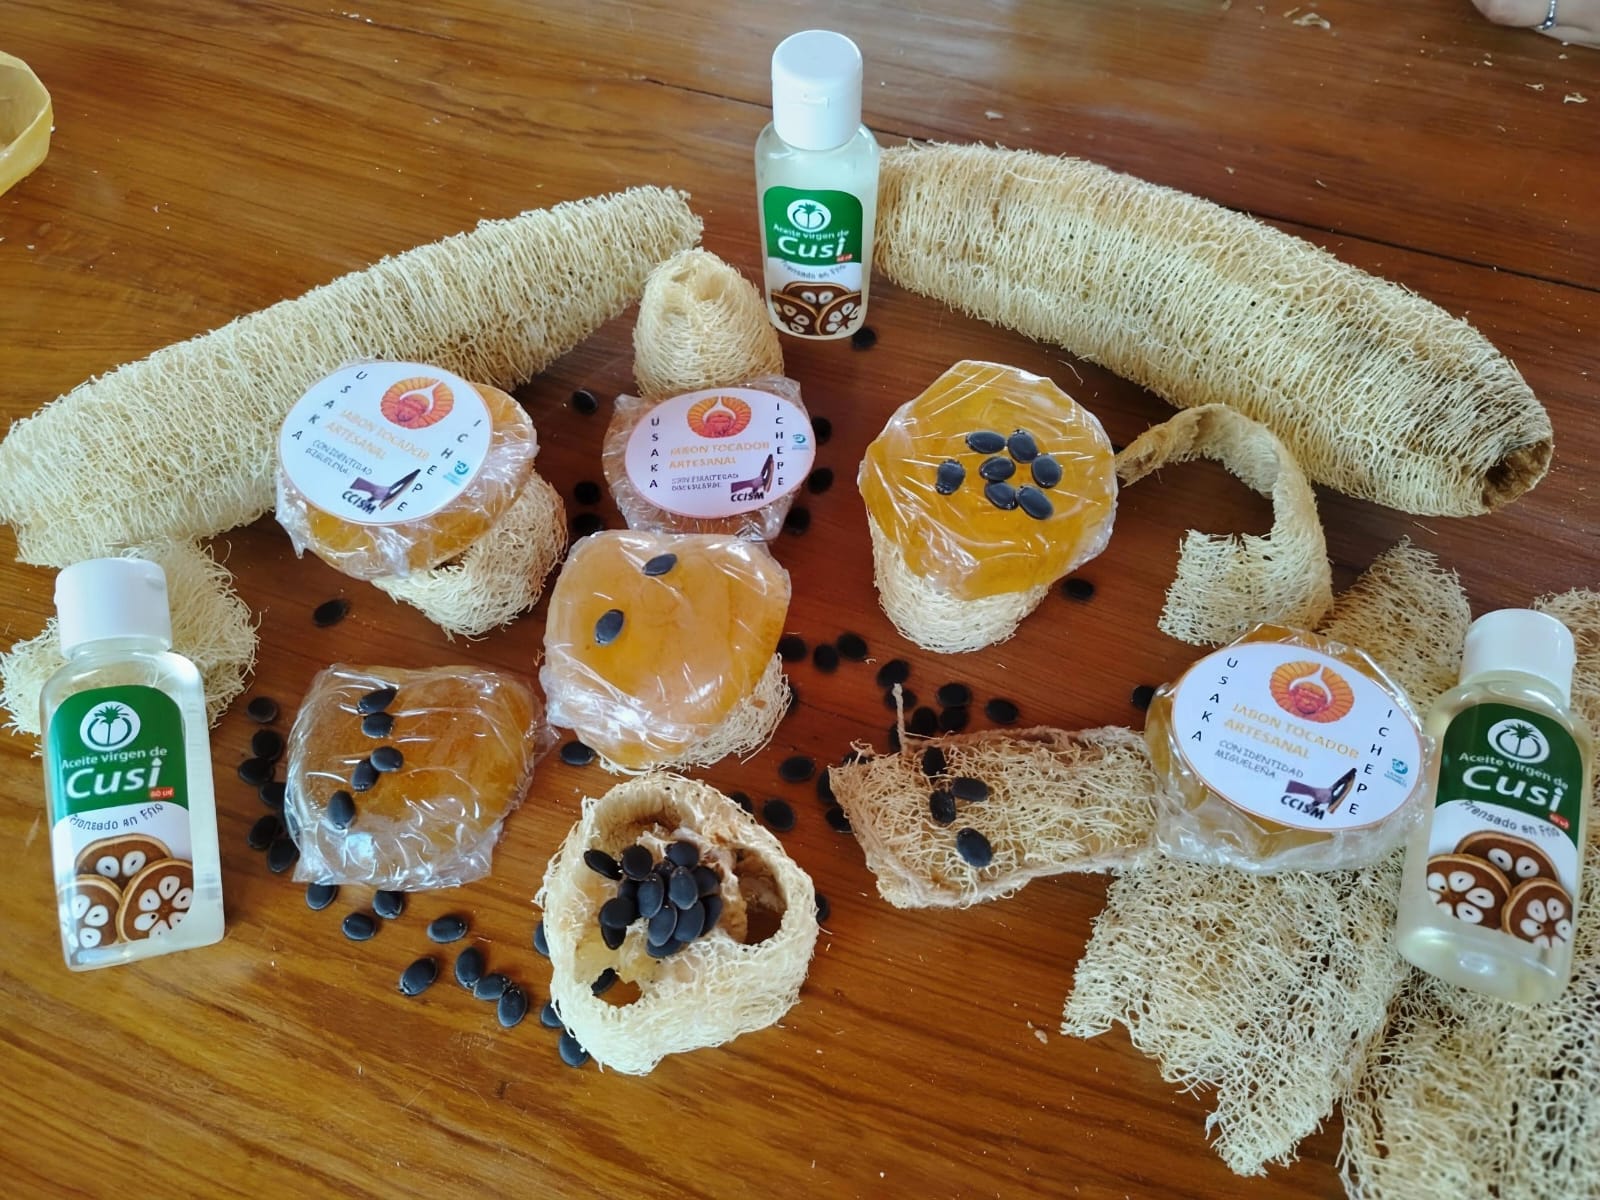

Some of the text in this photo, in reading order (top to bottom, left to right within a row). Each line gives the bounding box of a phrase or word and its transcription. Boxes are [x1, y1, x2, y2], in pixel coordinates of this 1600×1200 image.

[777, 235, 847, 258] Cusi
[803, 231, 835, 241] virgen
[342, 490, 376, 515] CCISM
[730, 492, 764, 502] CCISM
[1224, 718, 1310, 760] ARTESANAL
[1285, 722, 1360, 759] TOCADOR
[61, 746, 168, 770] Aceite virgen de
[1458, 752, 1569, 790] Aceite virgen de
[66, 757, 163, 799] Cusi
[1462, 765, 1564, 812] Cusi
[1281, 794, 1325, 821] CCISM
[1459, 799, 1517, 831] Prensado
